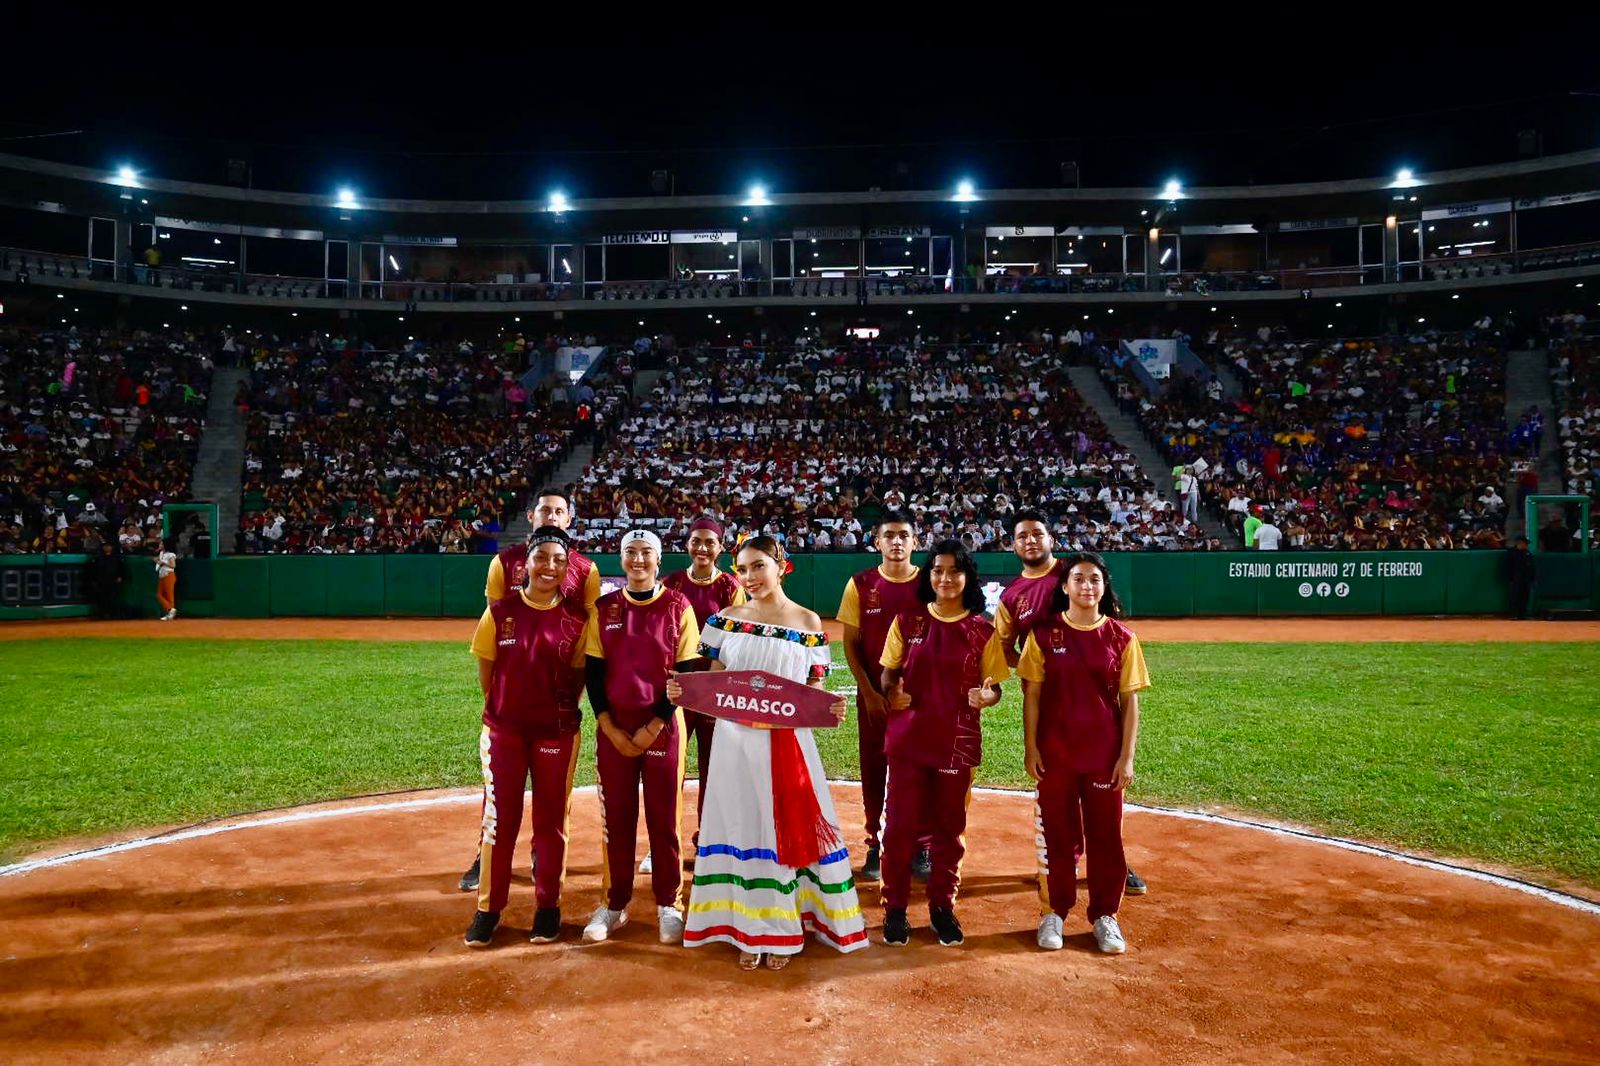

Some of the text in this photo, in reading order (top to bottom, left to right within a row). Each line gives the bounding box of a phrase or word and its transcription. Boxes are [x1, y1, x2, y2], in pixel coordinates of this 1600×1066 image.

[603, 232, 640, 243] TECATE
[1229, 562, 1423, 578] ESTADIO CENTENARIO 27 DE FEBRERO
[715, 693, 796, 717] TABASCO
